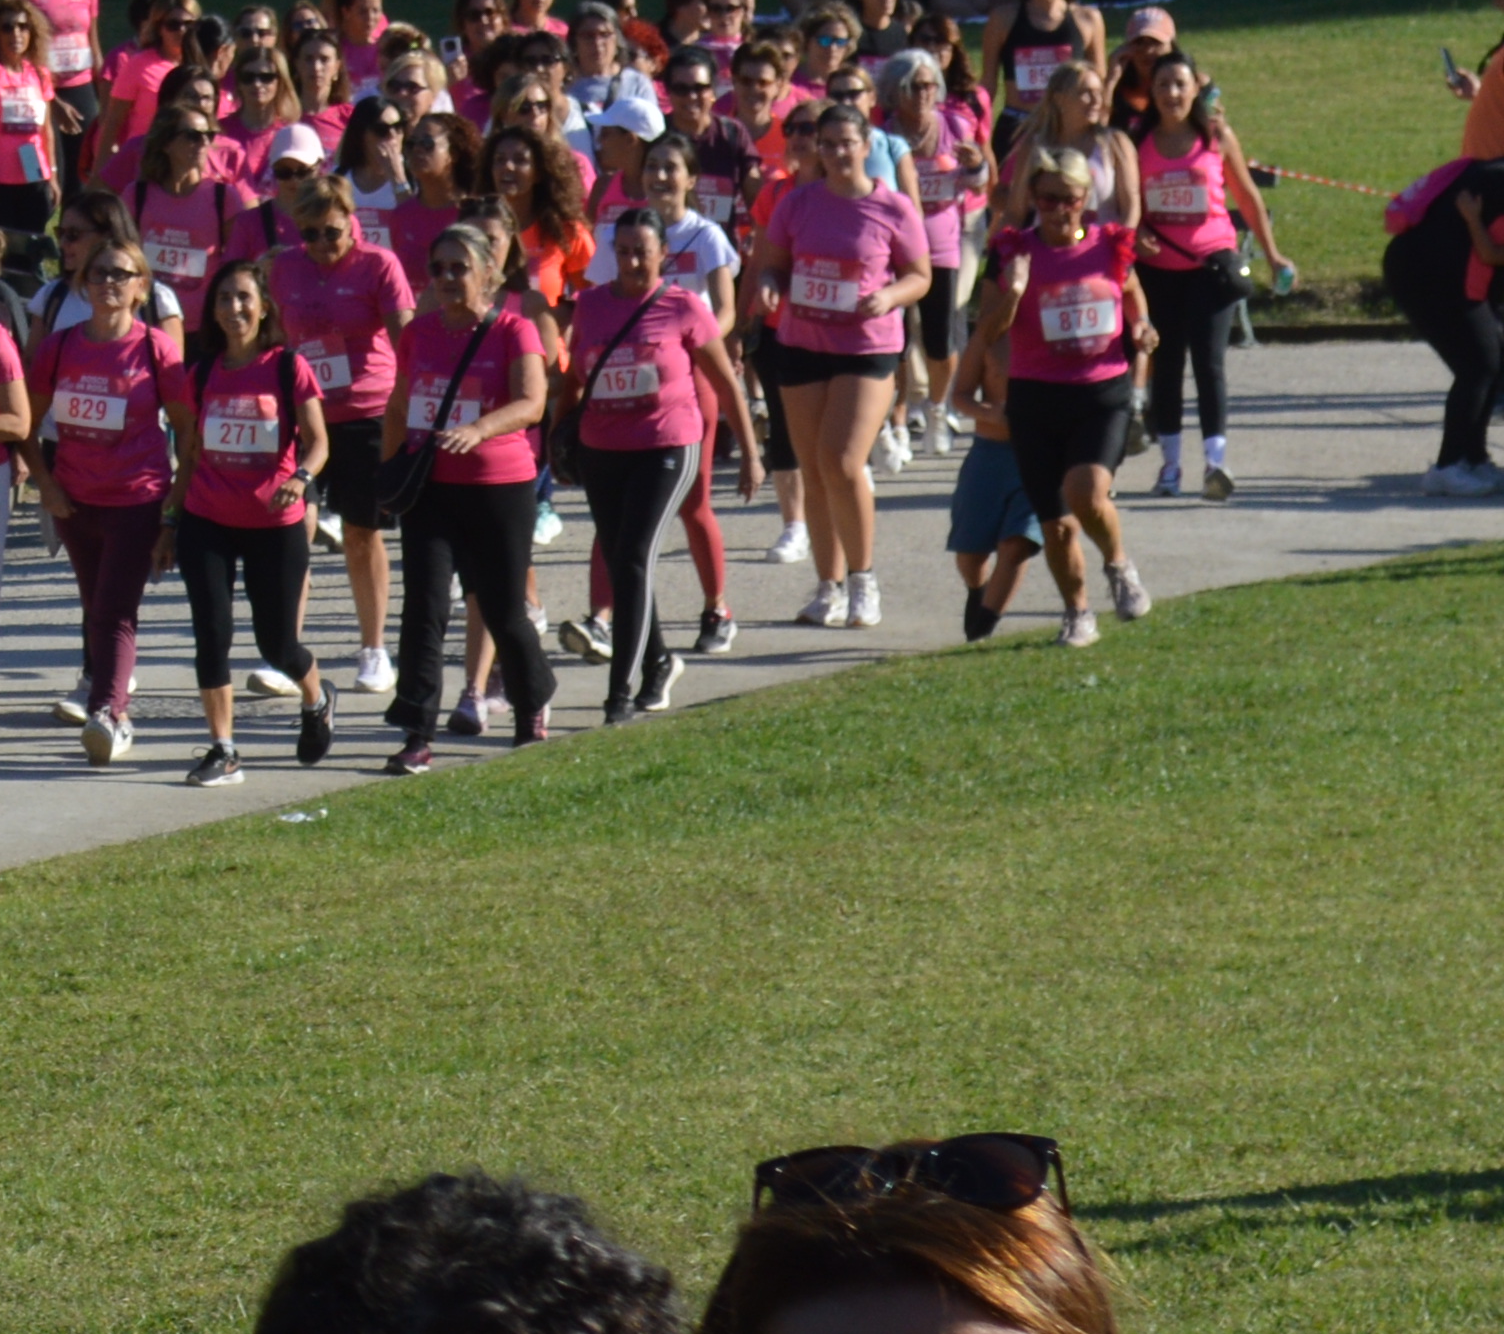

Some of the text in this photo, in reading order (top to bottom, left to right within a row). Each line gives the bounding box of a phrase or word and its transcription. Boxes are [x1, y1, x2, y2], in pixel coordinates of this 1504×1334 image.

[806, 281, 839, 304] 391
[1058, 306, 1097, 331] 879
[605, 370, 638, 392] 167
[68, 396, 107, 421] 829
[424, 401, 462, 424] 34
[220, 422, 257, 446] 271
